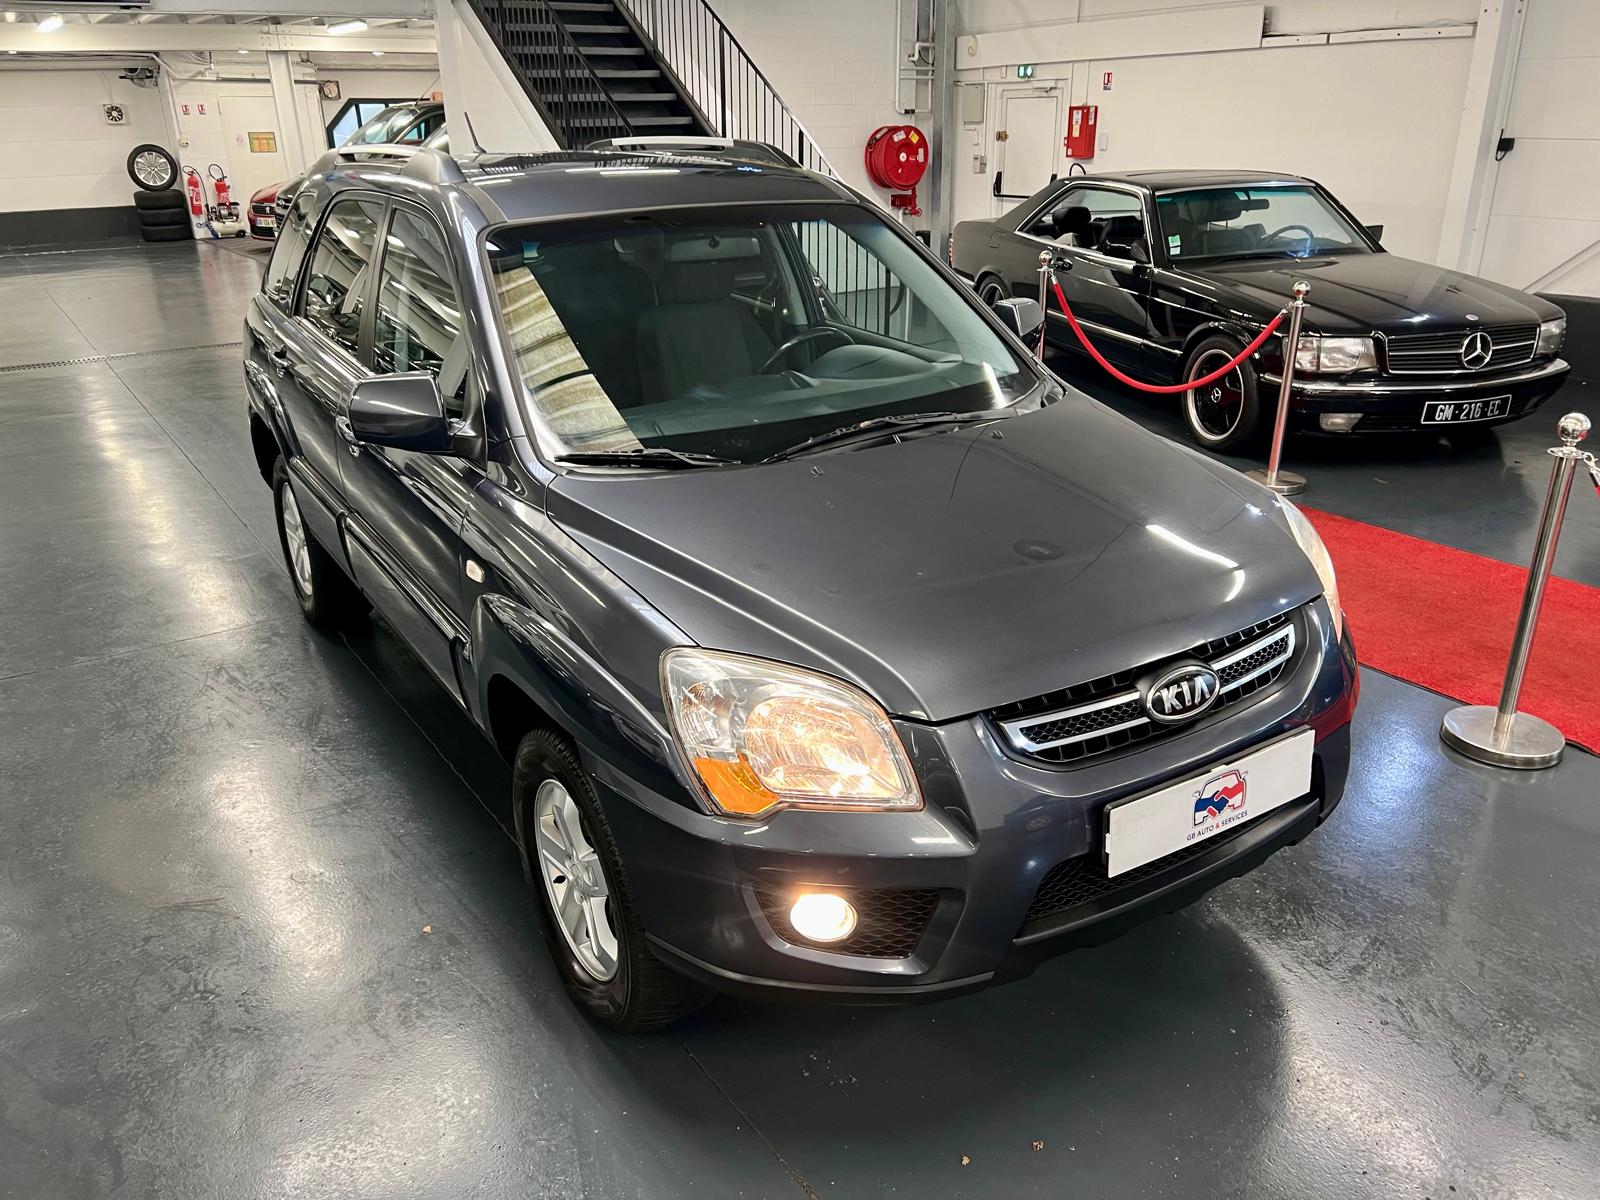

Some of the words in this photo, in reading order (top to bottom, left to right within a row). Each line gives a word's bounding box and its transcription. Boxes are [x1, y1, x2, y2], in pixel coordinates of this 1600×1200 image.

[1160, 675, 1211, 714] KIA
[1186, 832, 1196, 841] GB
[1197, 825, 1215, 837] AUTO
[1221, 810, 1248, 827] SERVICES
